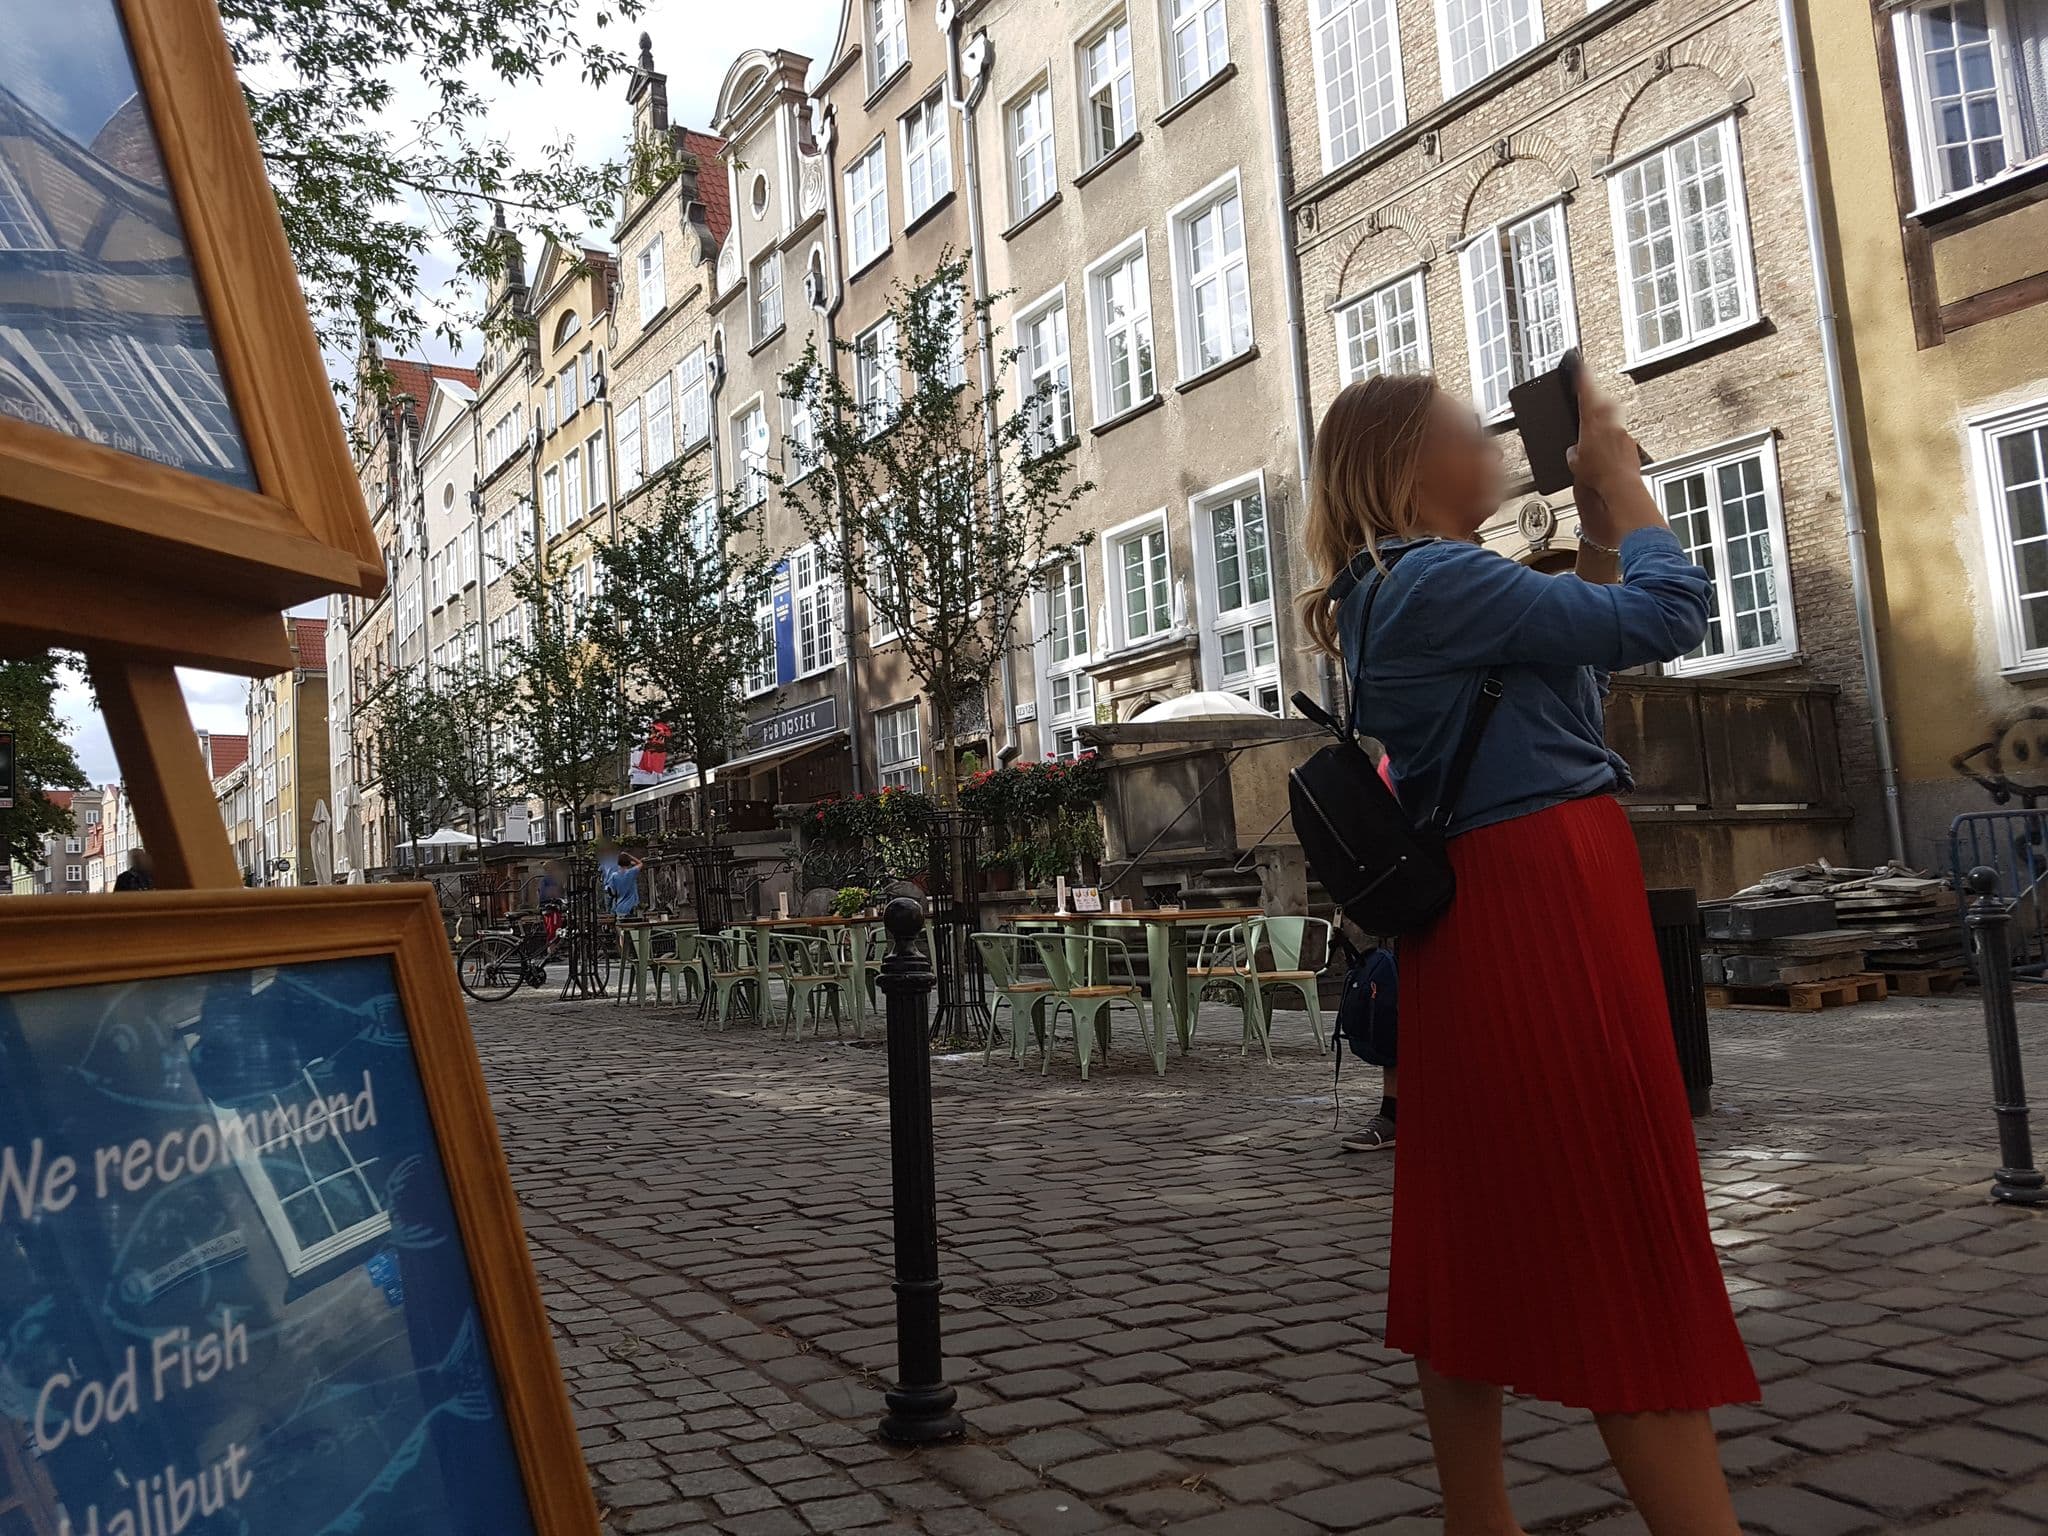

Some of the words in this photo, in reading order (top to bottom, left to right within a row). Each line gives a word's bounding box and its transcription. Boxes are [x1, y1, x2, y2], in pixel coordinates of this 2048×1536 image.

[112, 431, 137, 455] full
[141, 445, 185, 469] menu!
[763, 723, 779, 742] PUB
[781, 712, 817, 737] DUSZEK
[0, 1138, 77, 1223] We
[94, 1069, 377, 1198] recommend
[35, 1346, 138, 1450] Cod
[152, 1309, 248, 1401] Fish
